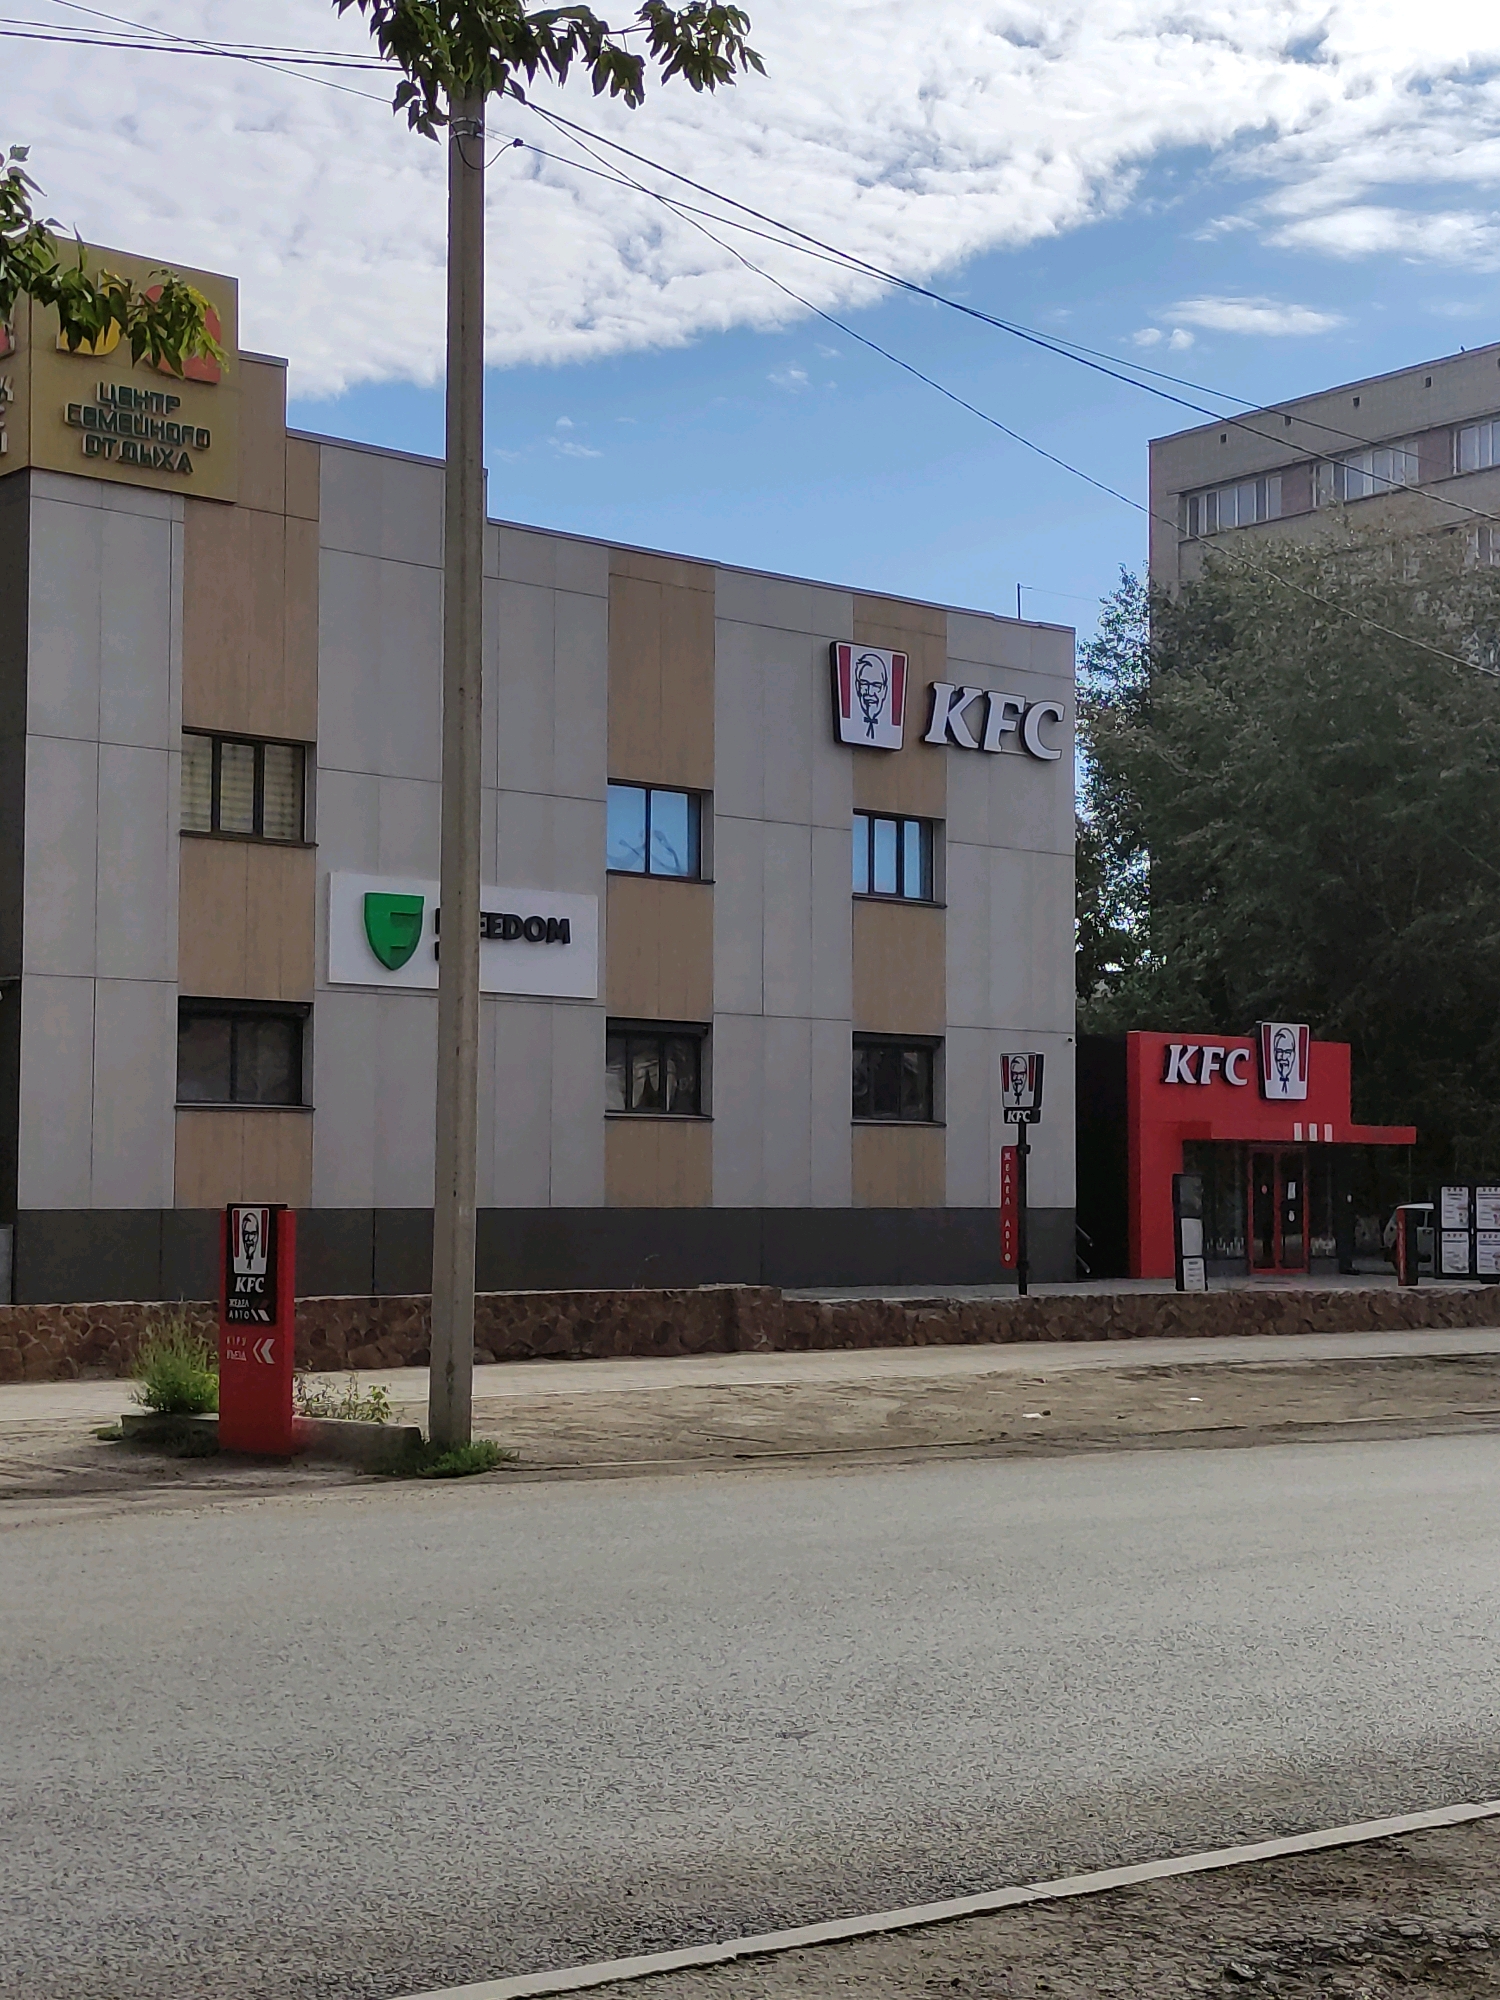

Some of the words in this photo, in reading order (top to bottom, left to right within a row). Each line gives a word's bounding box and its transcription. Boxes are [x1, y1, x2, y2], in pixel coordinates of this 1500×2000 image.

[82, 433, 194, 474] ОТДЫХА
[923, 681, 1065, 760] KFC
[1163, 1044, 1250, 1086] KFC
[1006, 1110, 1031, 1123] KFC
[235, 1276, 265, 1293] KFC
